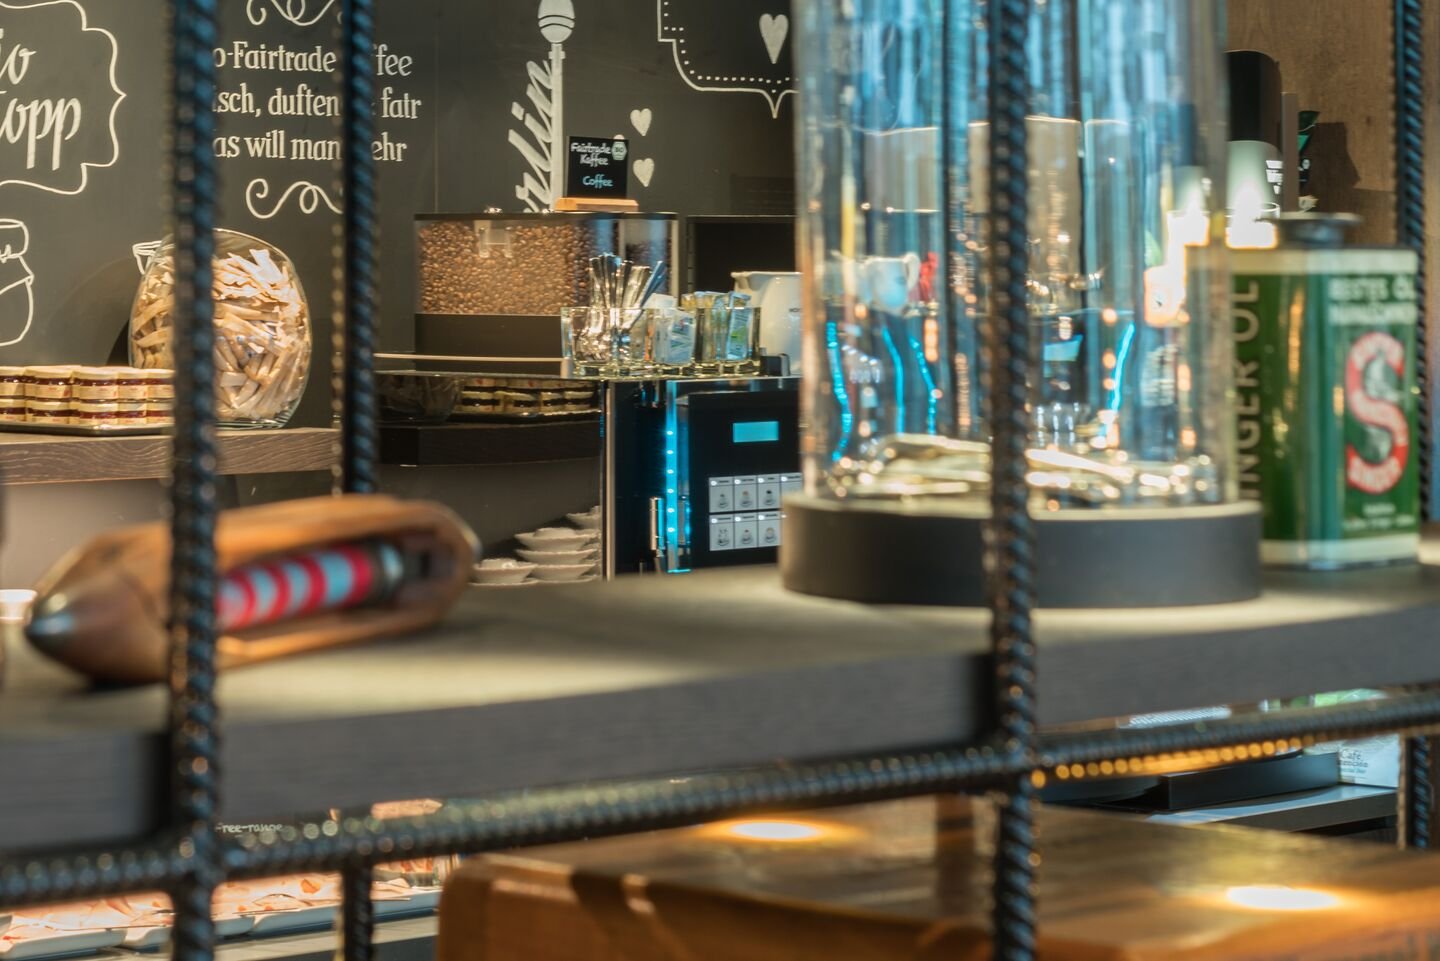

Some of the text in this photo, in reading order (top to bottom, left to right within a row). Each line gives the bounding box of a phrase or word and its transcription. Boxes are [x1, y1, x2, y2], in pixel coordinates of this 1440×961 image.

[212, 41, 337, 73] o-Fairtrade
[268, 83, 341, 117] duften
[381, 86, 422, 119] fair
[212, 129, 408, 162] as will man ehr
[582, 173, 614, 189] Coffee
